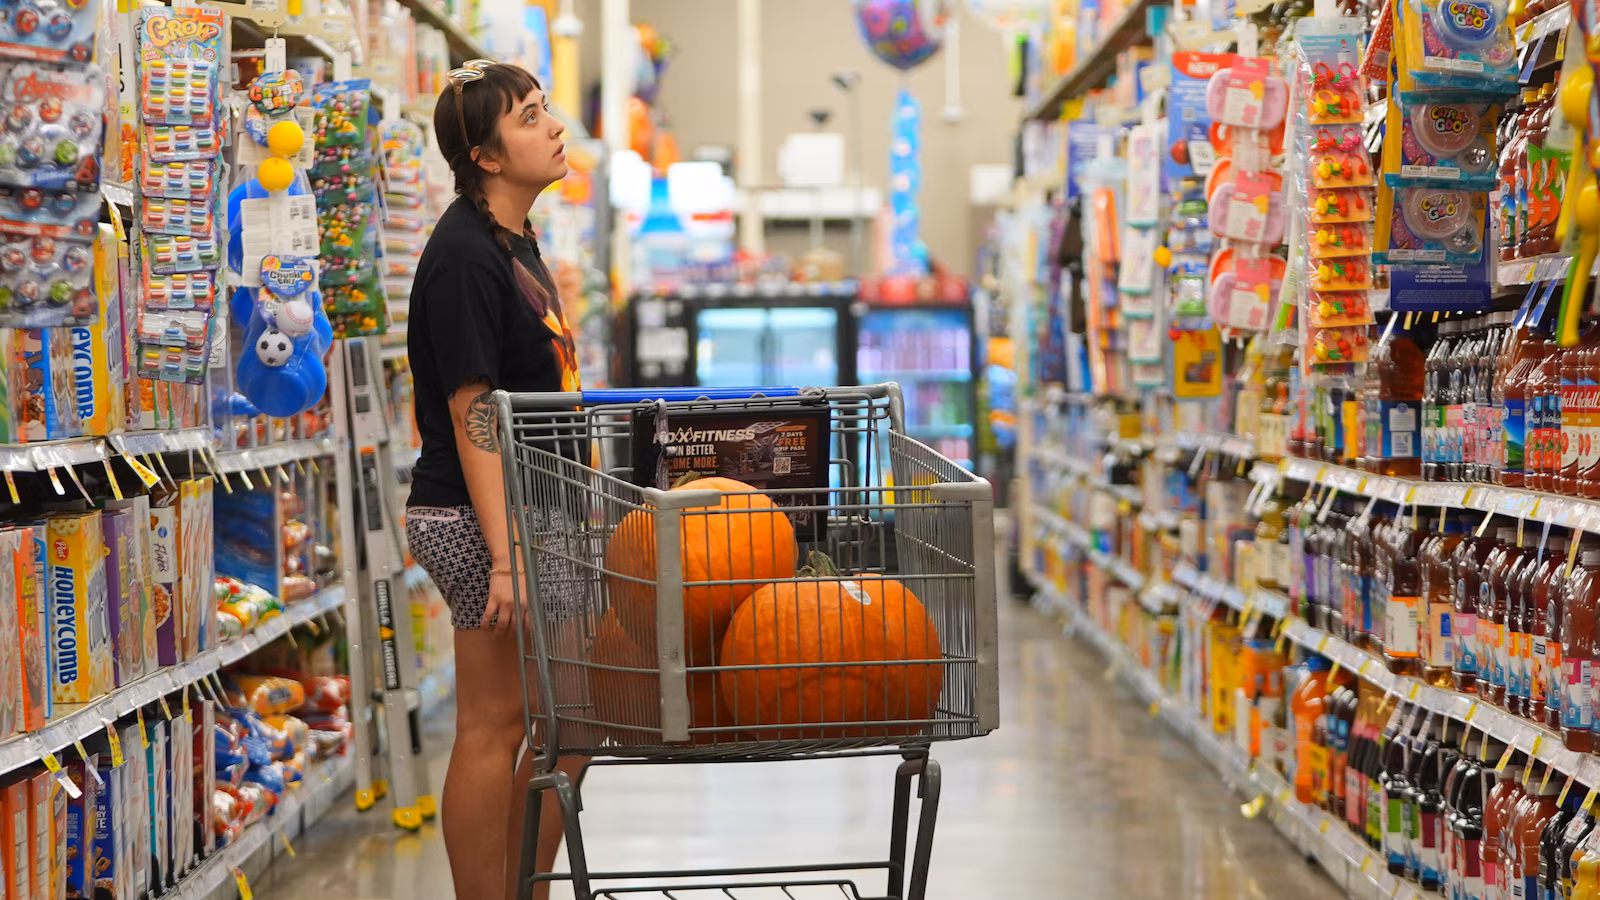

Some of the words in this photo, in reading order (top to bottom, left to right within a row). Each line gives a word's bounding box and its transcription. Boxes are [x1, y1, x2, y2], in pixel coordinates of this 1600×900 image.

[1455, 13, 1483, 28] GOO
[1435, 118, 1462, 133] GOO
[1427, 203, 1457, 221] GOO
[778, 437, 806, 447] FREE
[685, 444, 717, 456] BETTER.
[693, 456, 720, 469] MORE.
[55, 540, 68, 560] Post
[153, 543, 168, 573] Flakes
[377, 581, 389, 625] GORILLA
